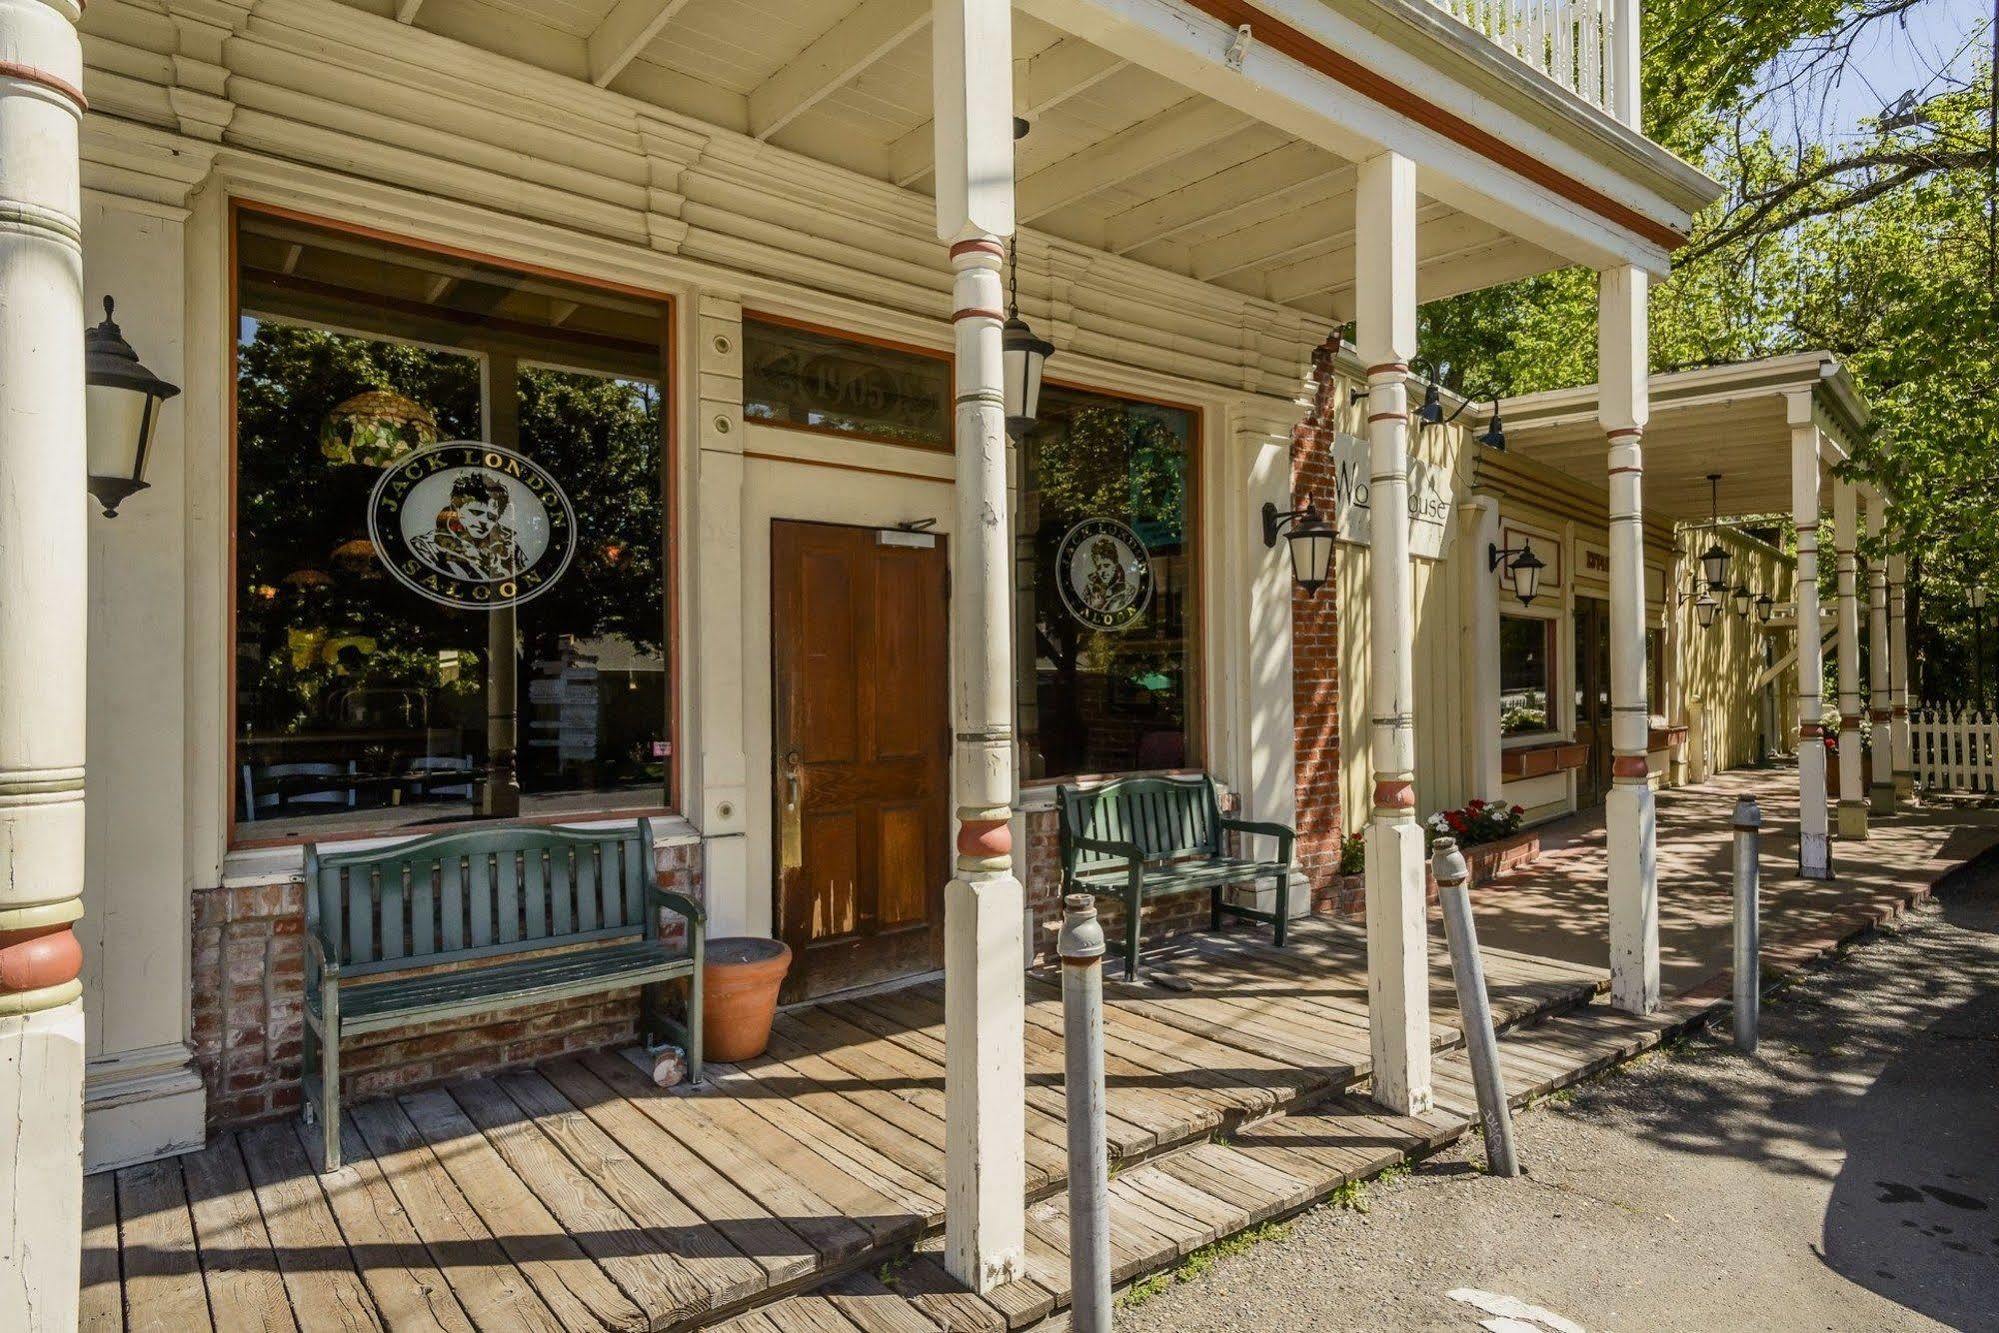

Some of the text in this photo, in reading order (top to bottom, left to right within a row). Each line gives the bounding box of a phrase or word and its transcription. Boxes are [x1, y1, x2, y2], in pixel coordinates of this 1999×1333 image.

[381, 450, 567, 528] JACK LONDON
[1334, 460, 1447, 520] Wo ouse
[402, 557, 542, 601] SALOON
